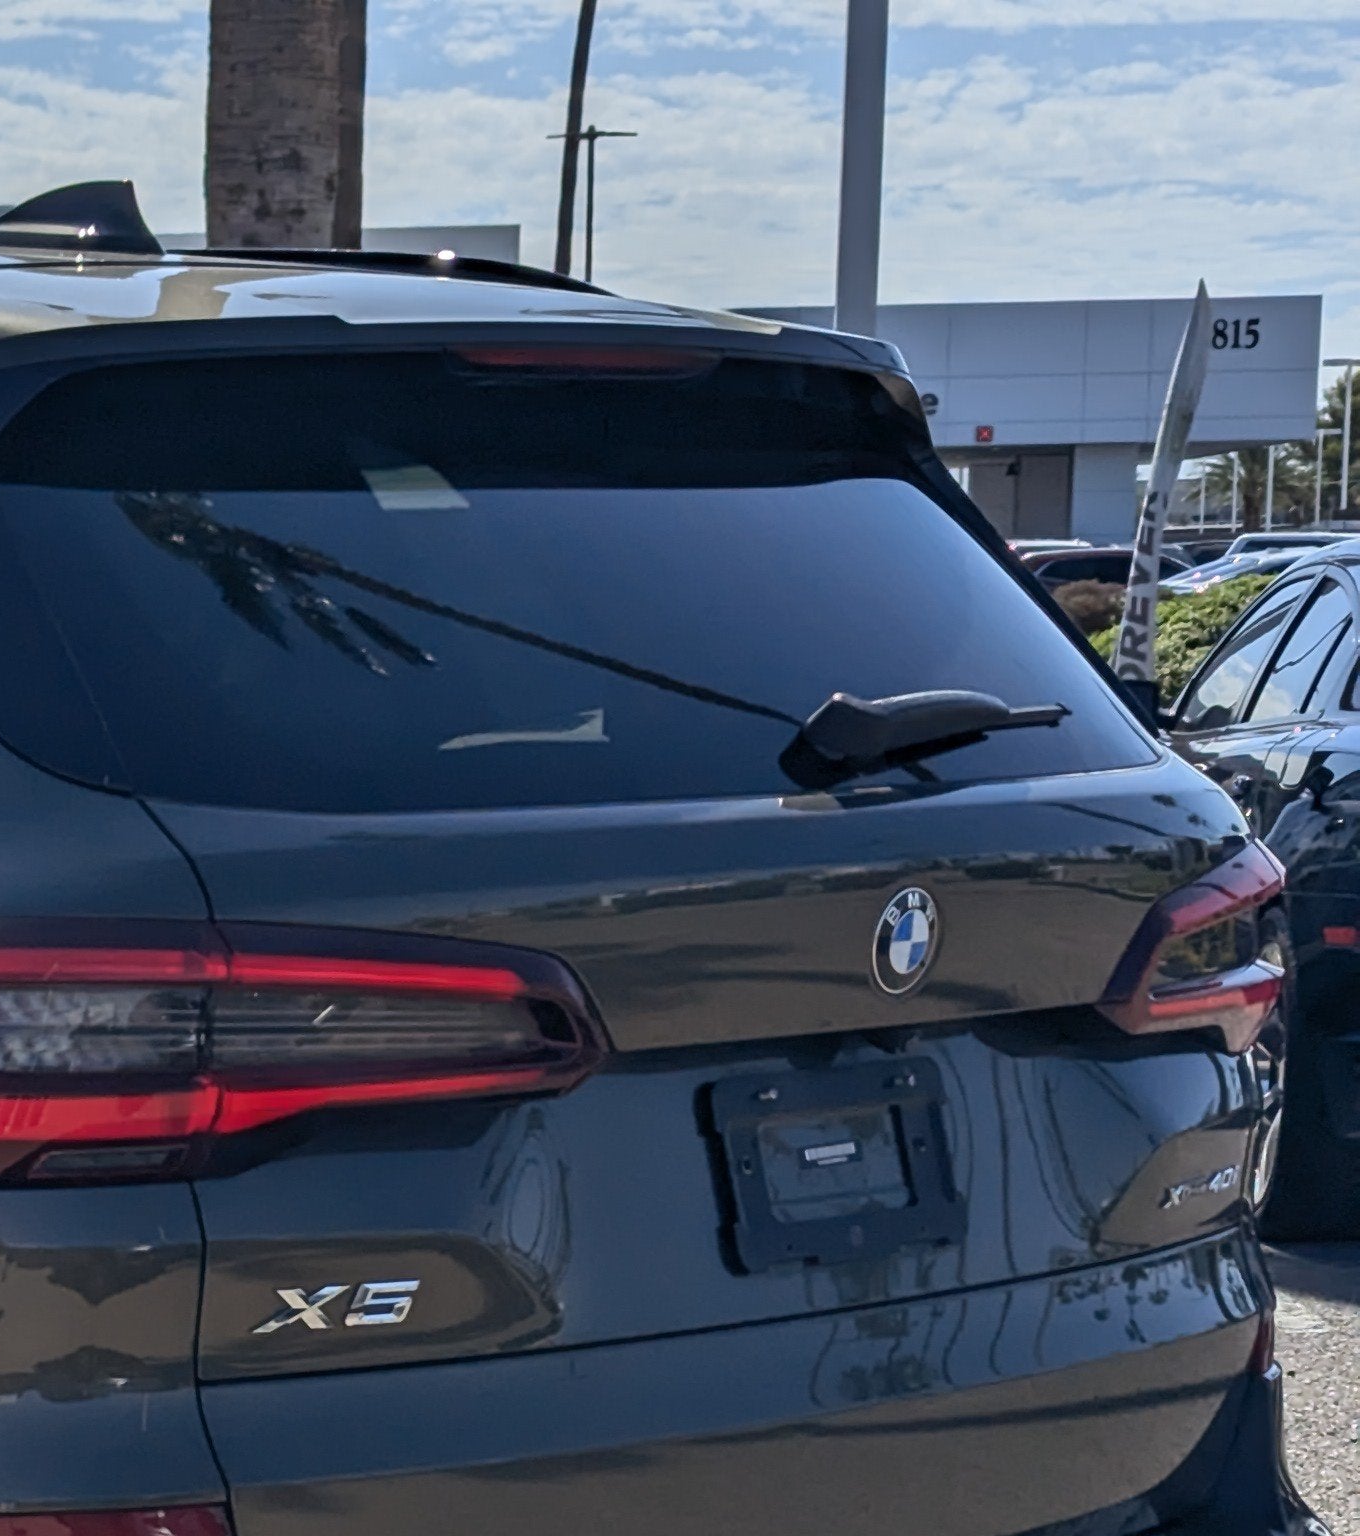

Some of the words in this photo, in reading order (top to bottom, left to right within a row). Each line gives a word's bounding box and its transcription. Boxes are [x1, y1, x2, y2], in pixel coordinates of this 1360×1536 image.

[1210, 318, 1260, 350] 815
[886, 892, 936, 926] BMW
[252, 1278, 421, 1335] X5
